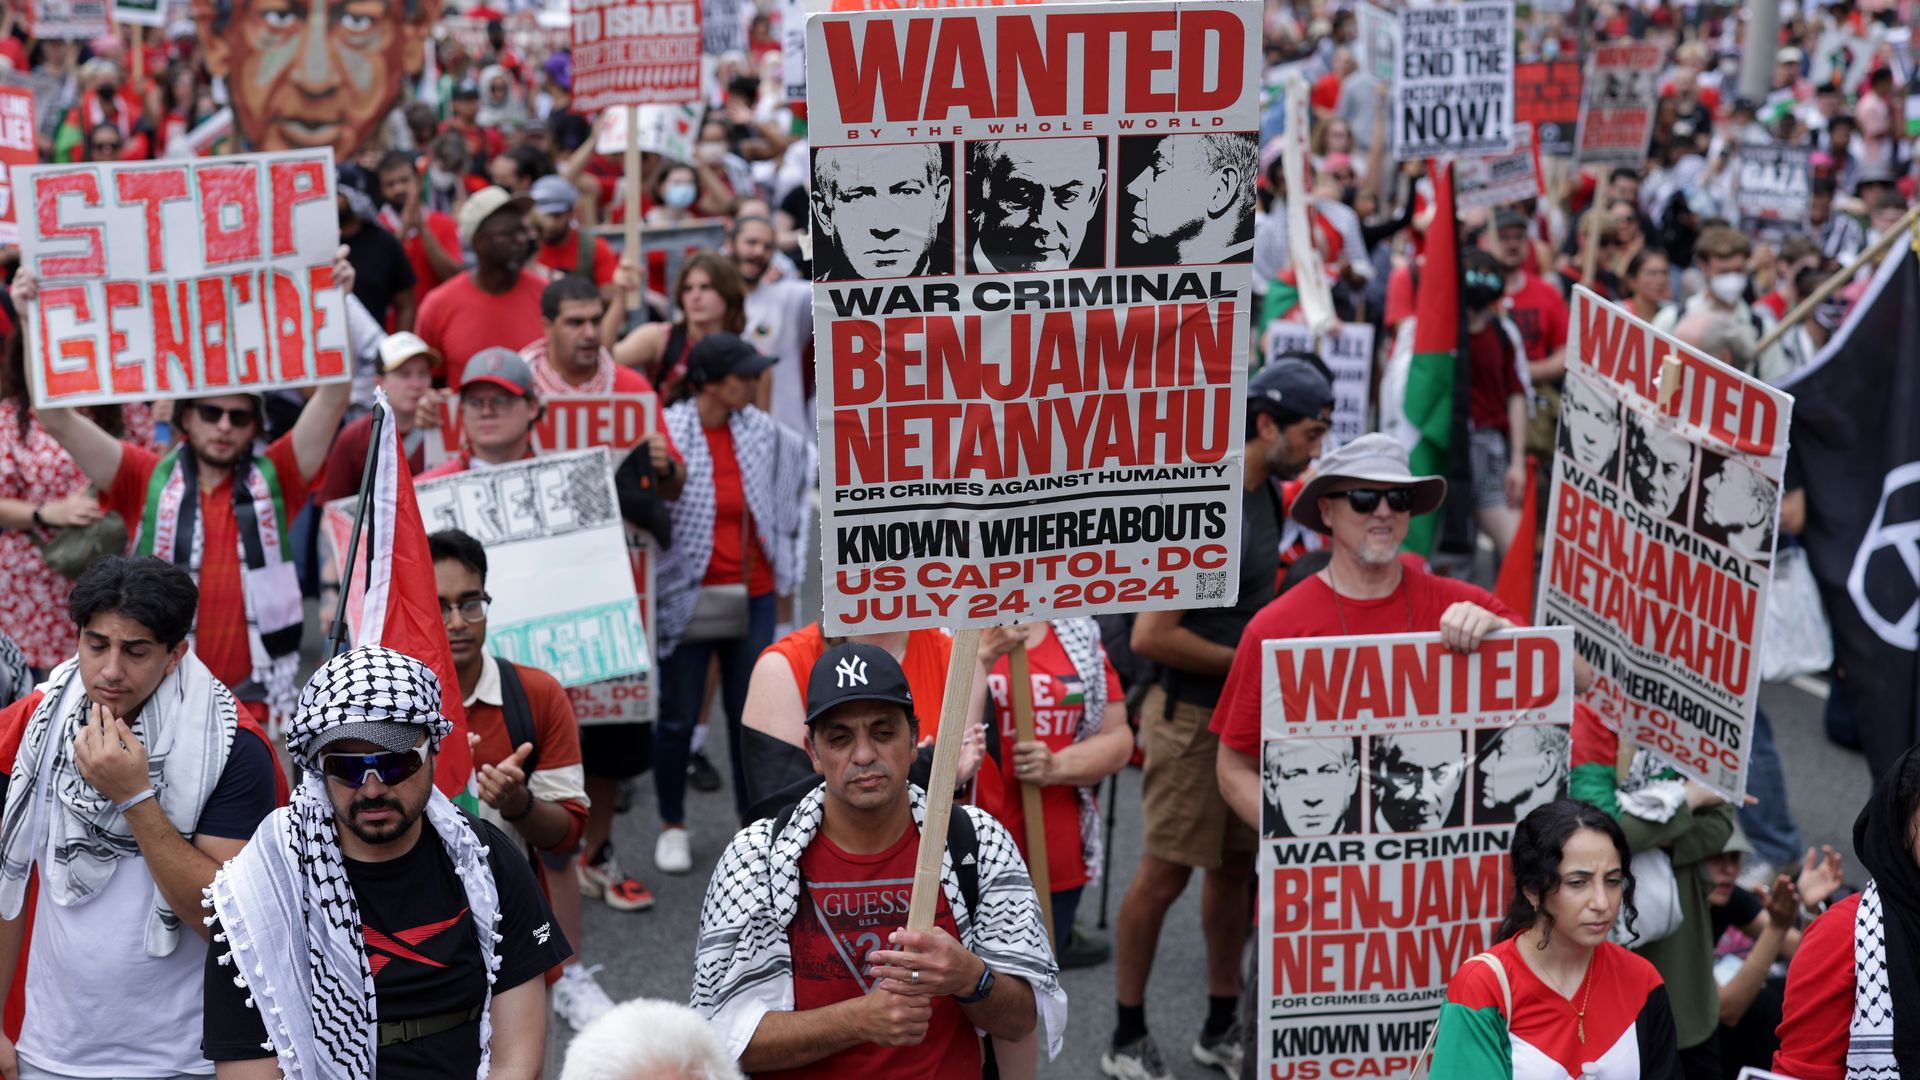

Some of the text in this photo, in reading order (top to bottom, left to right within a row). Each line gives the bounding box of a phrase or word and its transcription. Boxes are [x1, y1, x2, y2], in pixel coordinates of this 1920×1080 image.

[573, 11, 602, 45] TO
[605, 4, 700, 37] ISRAEL
[632, 38, 698, 60] GENOCIDE
[823, 10, 1246, 124] WANTED
[1404, 48, 1506, 79] END THE
[847, 115, 1226, 140] BY THE WHOLE WORLD
[1404, 99, 1502, 142] NOW!
[32, 157, 328, 279] STOP
[828, 271, 1239, 317] WAR CRIMINAL
[38, 264, 347, 400] GENOCIDE
[831, 301, 1236, 408] BENJAMIN
[1578, 295, 1778, 457] WANTED
[438, 399, 645, 453] WNTED
[833, 387, 1232, 487] NETANYAHU
[835, 464, 1229, 503] FOR CRIMES AGAINST HUMANITY
[837, 501, 1227, 565] KNOWN WHEREABOUTS
[1563, 461, 1760, 588] WAR CRIMINAL
[836, 543, 1228, 596] US CAPITOL DC
[1556, 480, 1758, 645] BENJAMIN
[839, 576, 1180, 625] JULY 24 2024
[1550, 537, 1751, 697] NETANYAHU
[835, 654, 869, 688] NY
[1275, 636, 1560, 723] WANTED
[1673, 664, 1745, 709] HUMANITY
[573, 702, 624, 719] 024
[1611, 652, 1742, 751] WHEREABOUTS
[1288, 726, 1314, 735] BY
[1329, 723, 1368, 734] THE
[1386, 717, 1459, 730] WHOLE
[1636, 725, 1710, 774] 2024
[1699, 736, 1740, 771] DC
[1273, 831, 1510, 865] WAR CRIMIN
[823, 890, 910, 917] GUESS
[1273, 853, 1517, 934] BENJAMI
[533, 921, 550, 937] Reebok
[859, 918, 881, 926] U.S.A.
[1272, 921, 1504, 996] NETANYA
[1272, 988, 1448, 1010] FOR CRIMES AGAINS
[1272, 1024, 1369, 1059] KNOWN
[1270, 1060, 1321, 1080] US
